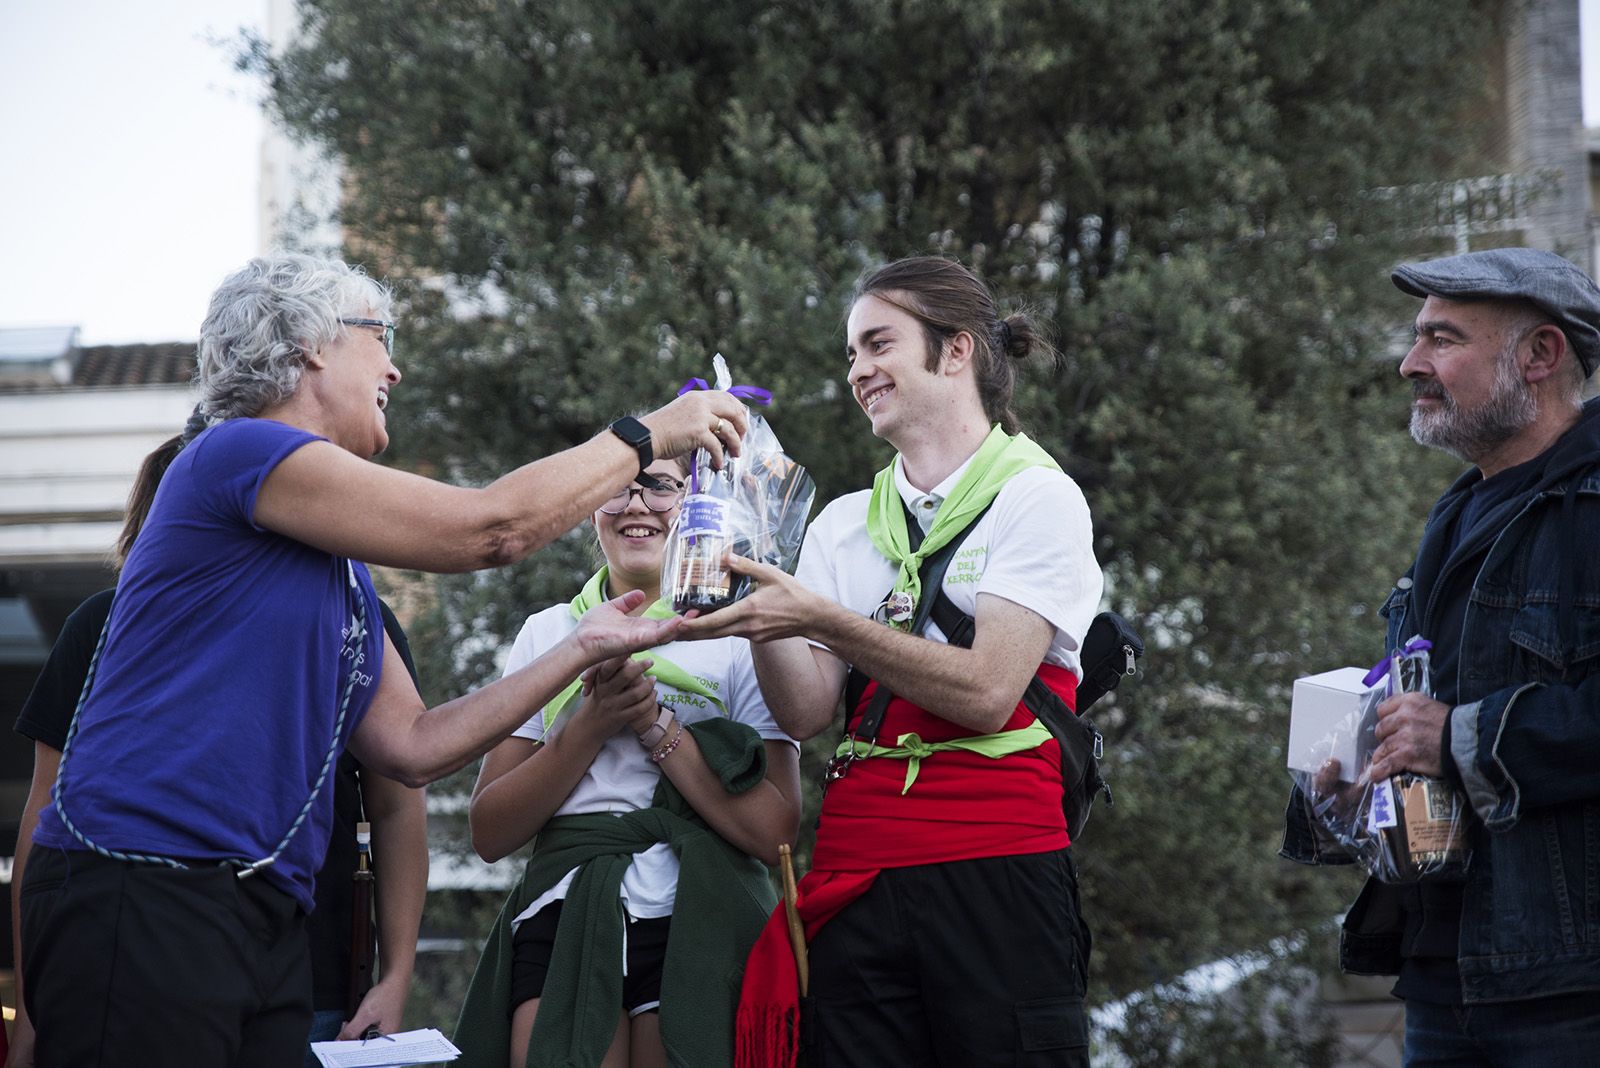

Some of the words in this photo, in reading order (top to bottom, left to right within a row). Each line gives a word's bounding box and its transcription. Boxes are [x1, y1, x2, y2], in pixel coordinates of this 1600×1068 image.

[957, 560, 976, 571] DEL
[693, 675, 719, 691] TONS
[662, 693, 706, 708] XERRAC
